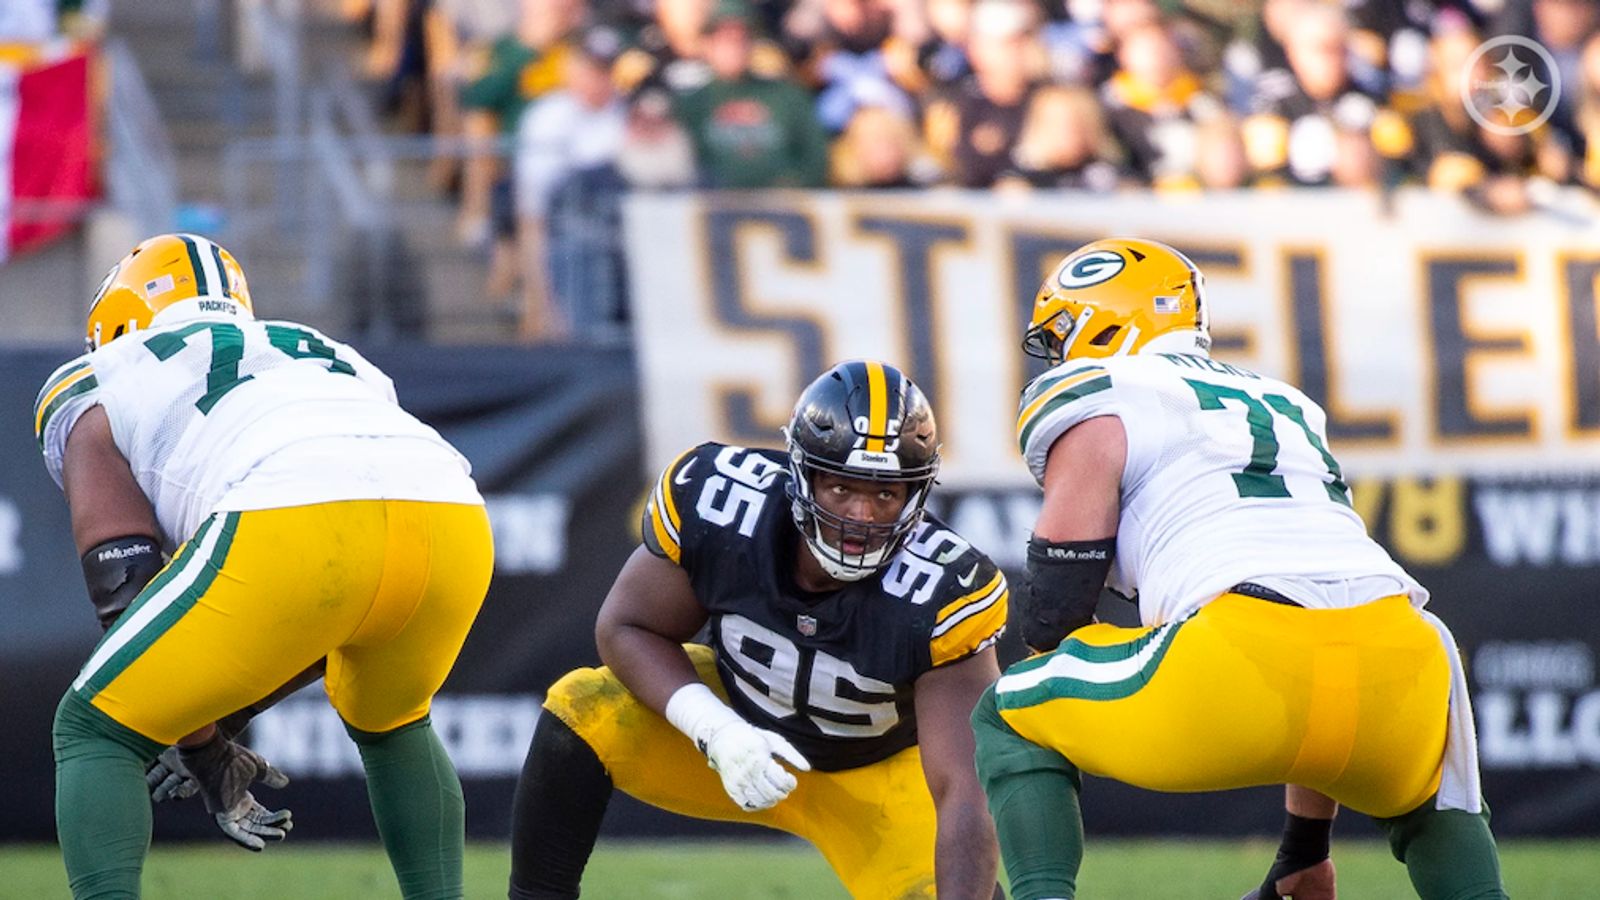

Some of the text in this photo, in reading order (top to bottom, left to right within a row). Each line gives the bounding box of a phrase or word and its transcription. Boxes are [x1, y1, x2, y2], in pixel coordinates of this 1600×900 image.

[1070, 257, 1125, 279] G
[702, 207, 1600, 448] STLE
[852, 416, 900, 452] 95
[1182, 377, 1353, 506] 71
[697, 446, 788, 538] 95
[882, 520, 970, 605] 95
[720, 614, 899, 738] 95
